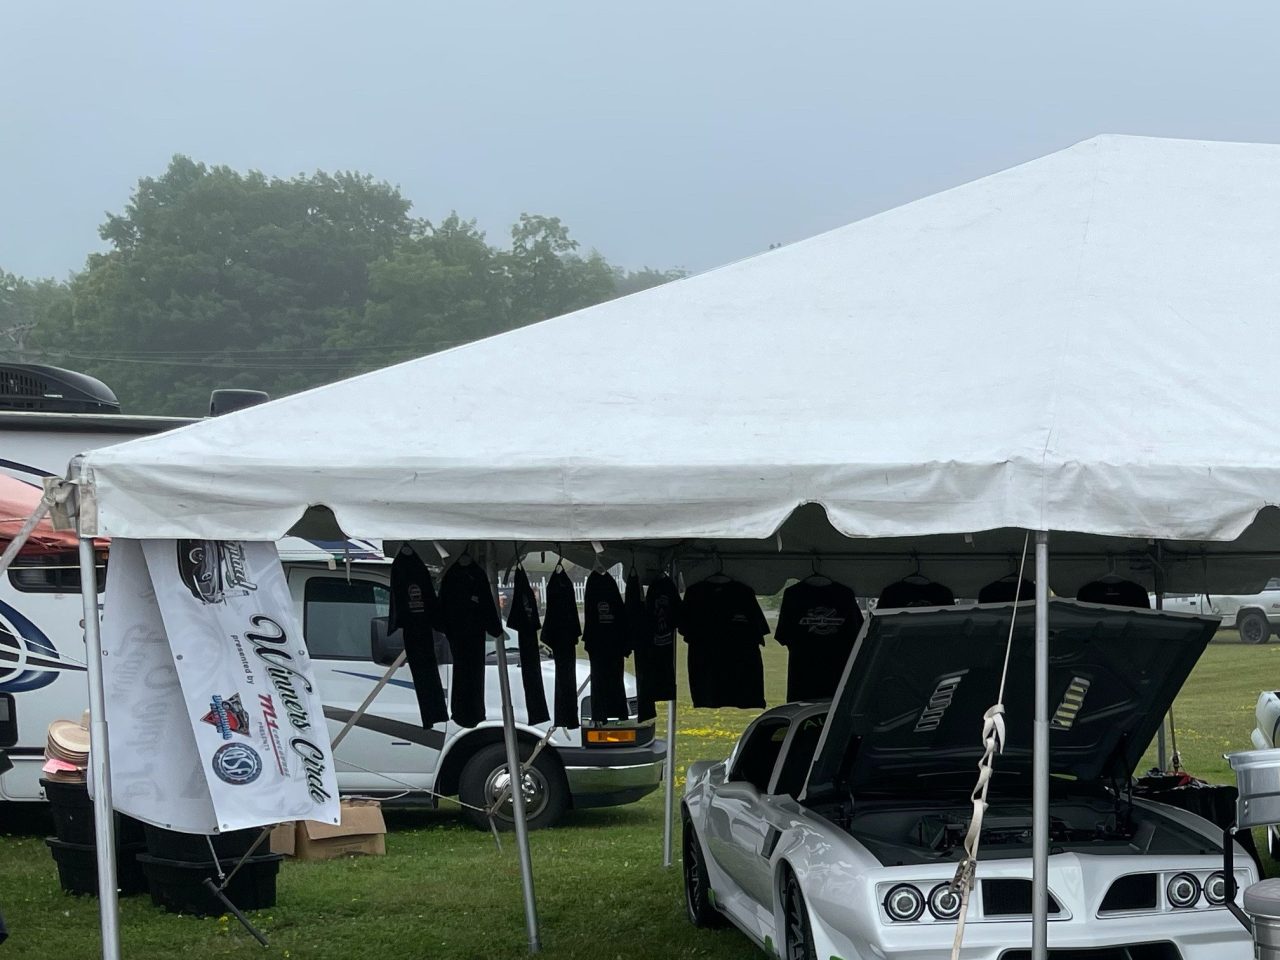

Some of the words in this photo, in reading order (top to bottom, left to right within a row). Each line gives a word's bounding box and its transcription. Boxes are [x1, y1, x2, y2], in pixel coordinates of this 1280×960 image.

[223, 541, 258, 591] gnace!
[230, 634, 252, 674] presented
[245, 675, 256, 685] by
[243, 613, 314, 736] Winners
[290, 735, 332, 806] Circle
[257, 721, 271, 752] PRESENTS
